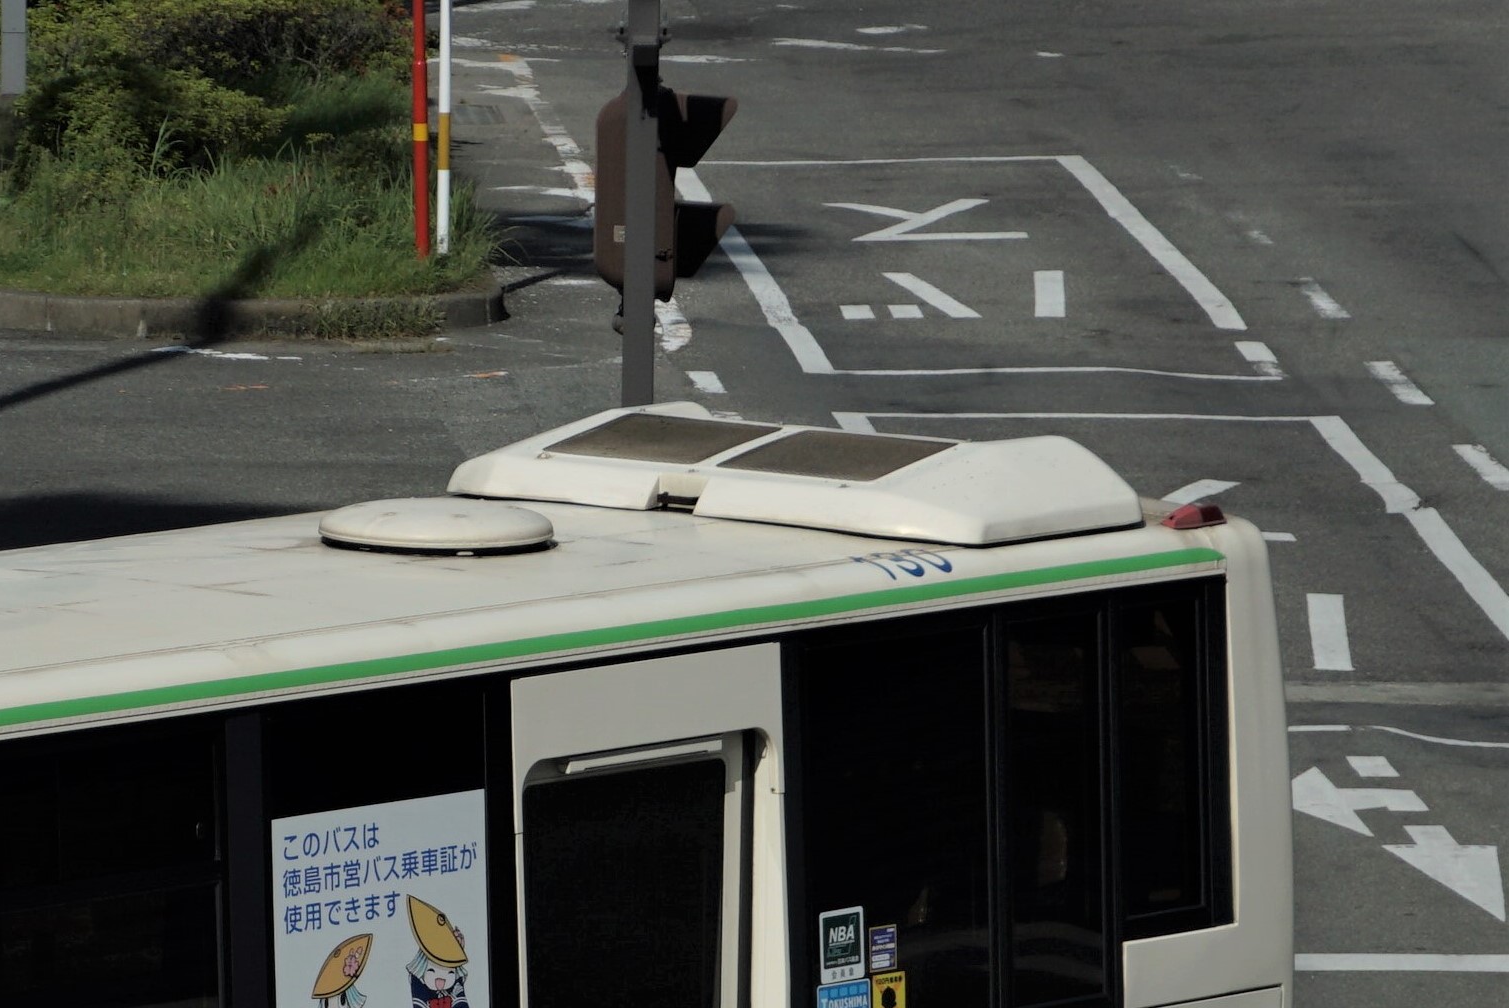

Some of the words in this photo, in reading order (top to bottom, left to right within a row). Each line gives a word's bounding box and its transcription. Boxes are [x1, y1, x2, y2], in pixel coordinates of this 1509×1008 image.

[283, 823, 379, 861] このバスは
[282, 842, 477, 898] 徳島市営バス乗車証が
[284, 891, 400, 935] 使用できます
[829, 925, 855, 943] NBA
